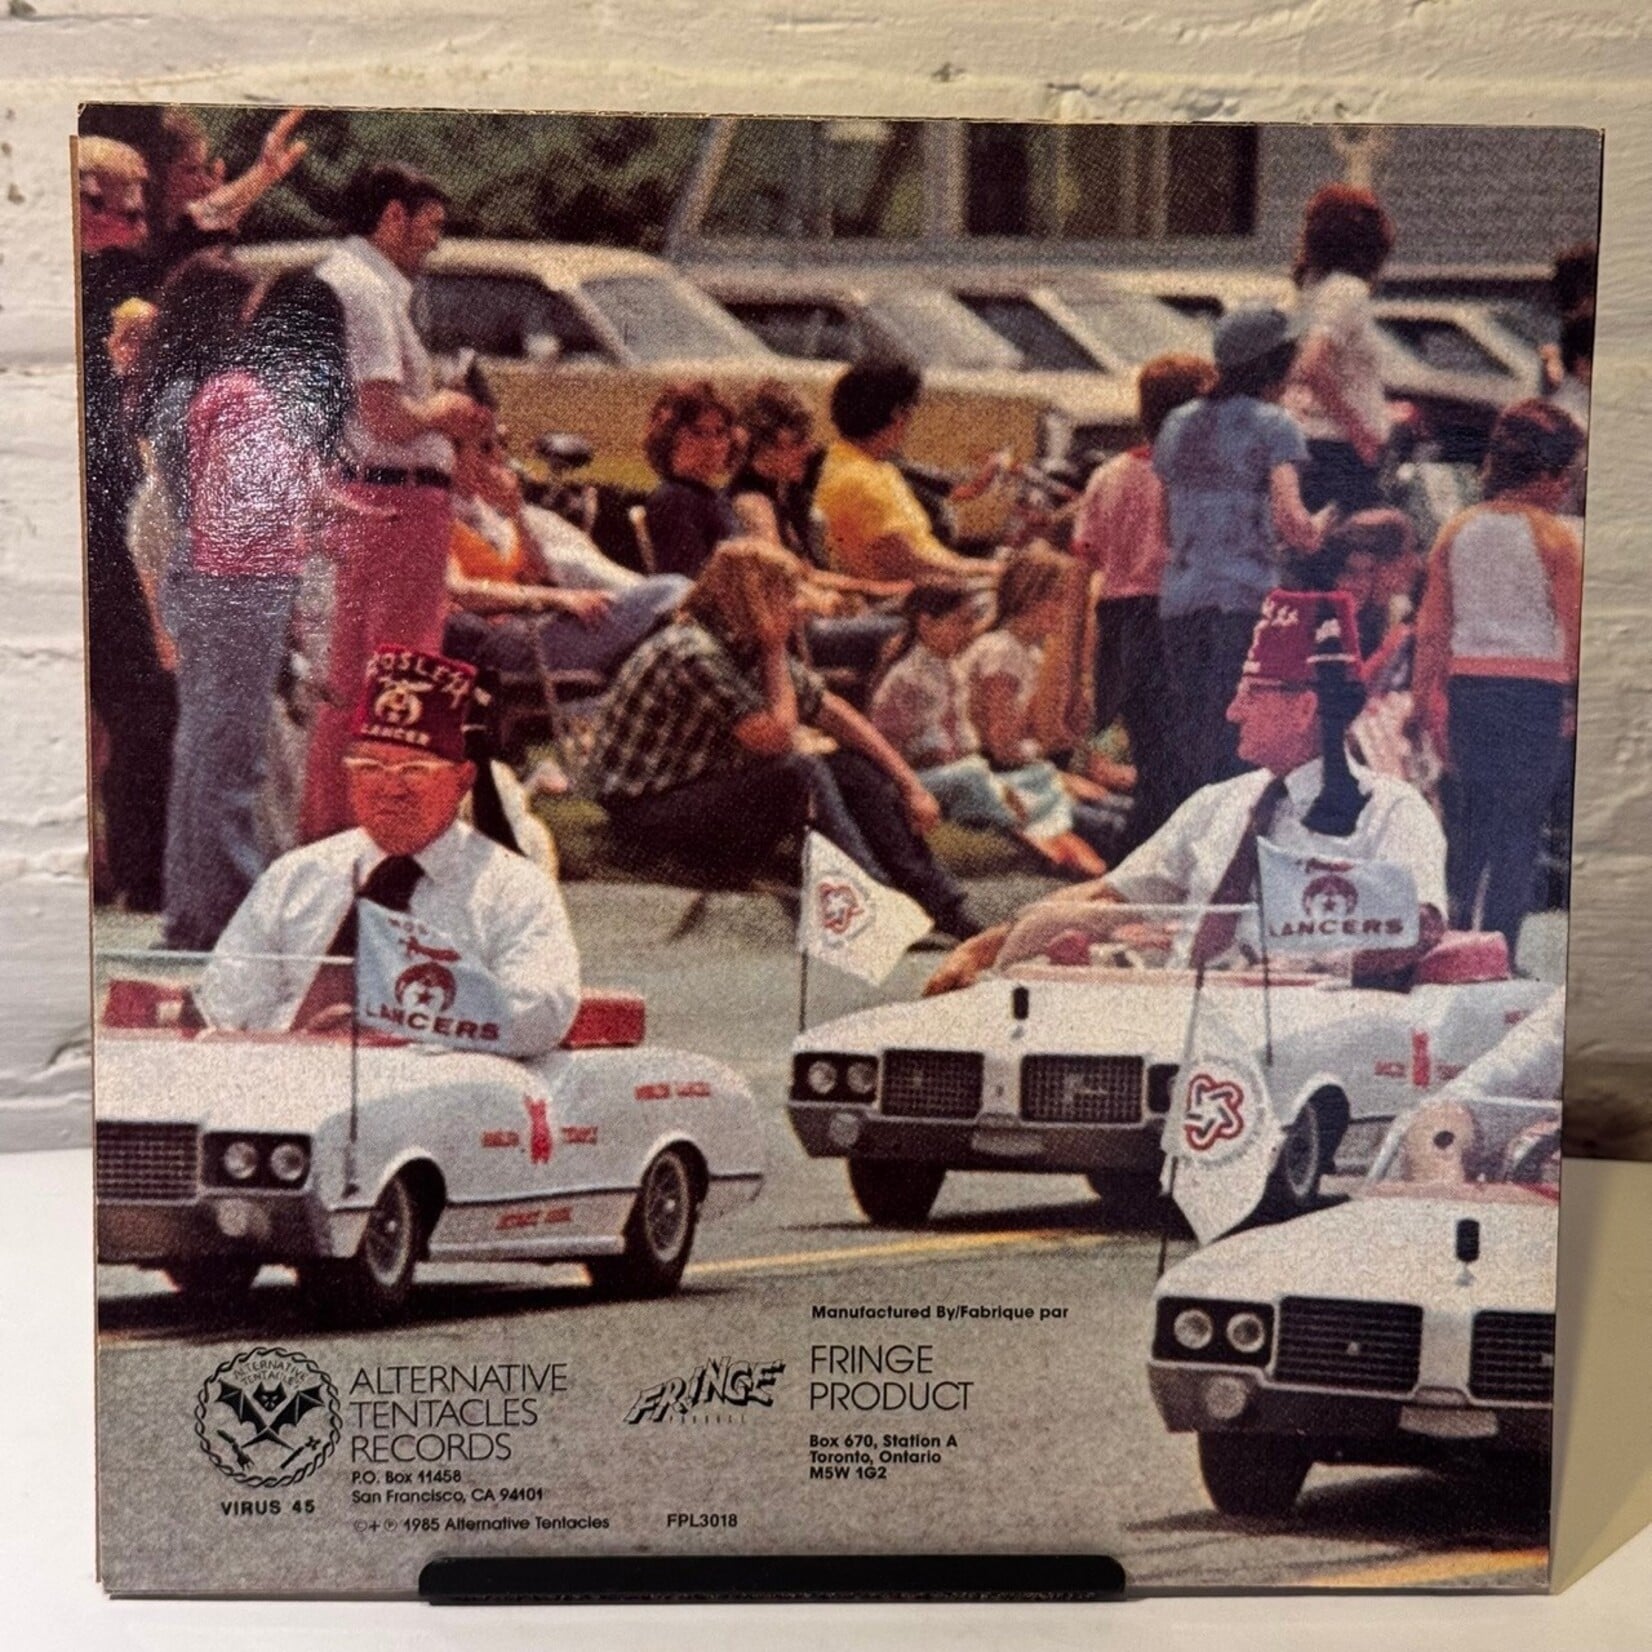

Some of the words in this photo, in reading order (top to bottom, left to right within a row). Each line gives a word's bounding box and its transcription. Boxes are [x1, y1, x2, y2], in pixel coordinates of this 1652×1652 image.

[1268, 917, 1404, 938] LANCERS
[366, 1001, 500, 1041] LANCERS
[812, 1305, 931, 1319] Manufactured
[936, 1305, 1035, 1321] By/Fabrique
[1039, 1308, 1069, 1321] par
[811, 1344, 933, 1374] FRINGE
[349, 1363, 568, 1395] ALTERNATIVE
[623, 1355, 786, 1425] FRINGE
[810, 1380, 974, 1411] PRODUCT
[349, 1397, 538, 1428] TENTACLES
[351, 1432, 512, 1464] RECORDS
[809, 1434, 839, 1448] Box
[844, 1434, 878, 1450] 670,
[883, 1433, 941, 1448] Station
[946, 1434, 958, 1448] A
[809, 1450, 874, 1466] Toronto,
[879, 1450, 942, 1464] Ontario
[351, 1470, 381, 1485] P.O.
[385, 1470, 413, 1484] Box
[417, 1469, 462, 1484] 11458
[809, 1466, 850, 1480] M5W
[855, 1466, 887, 1480] 1G2
[352, 1489, 382, 1504] San
[386, 1489, 467, 1504] Francisco,
[471, 1487, 496, 1503] CA
[499, 1487, 543, 1501] 94101
[220, 1499, 282, 1516] VIRUS
[291, 1499, 316, 1514] 45
[403, 1517, 440, 1532] 1985
[444, 1516, 531, 1532] Alternative
[535, 1515, 611, 1530] Tentacles
[667, 1513, 738, 1528] FPL3018
